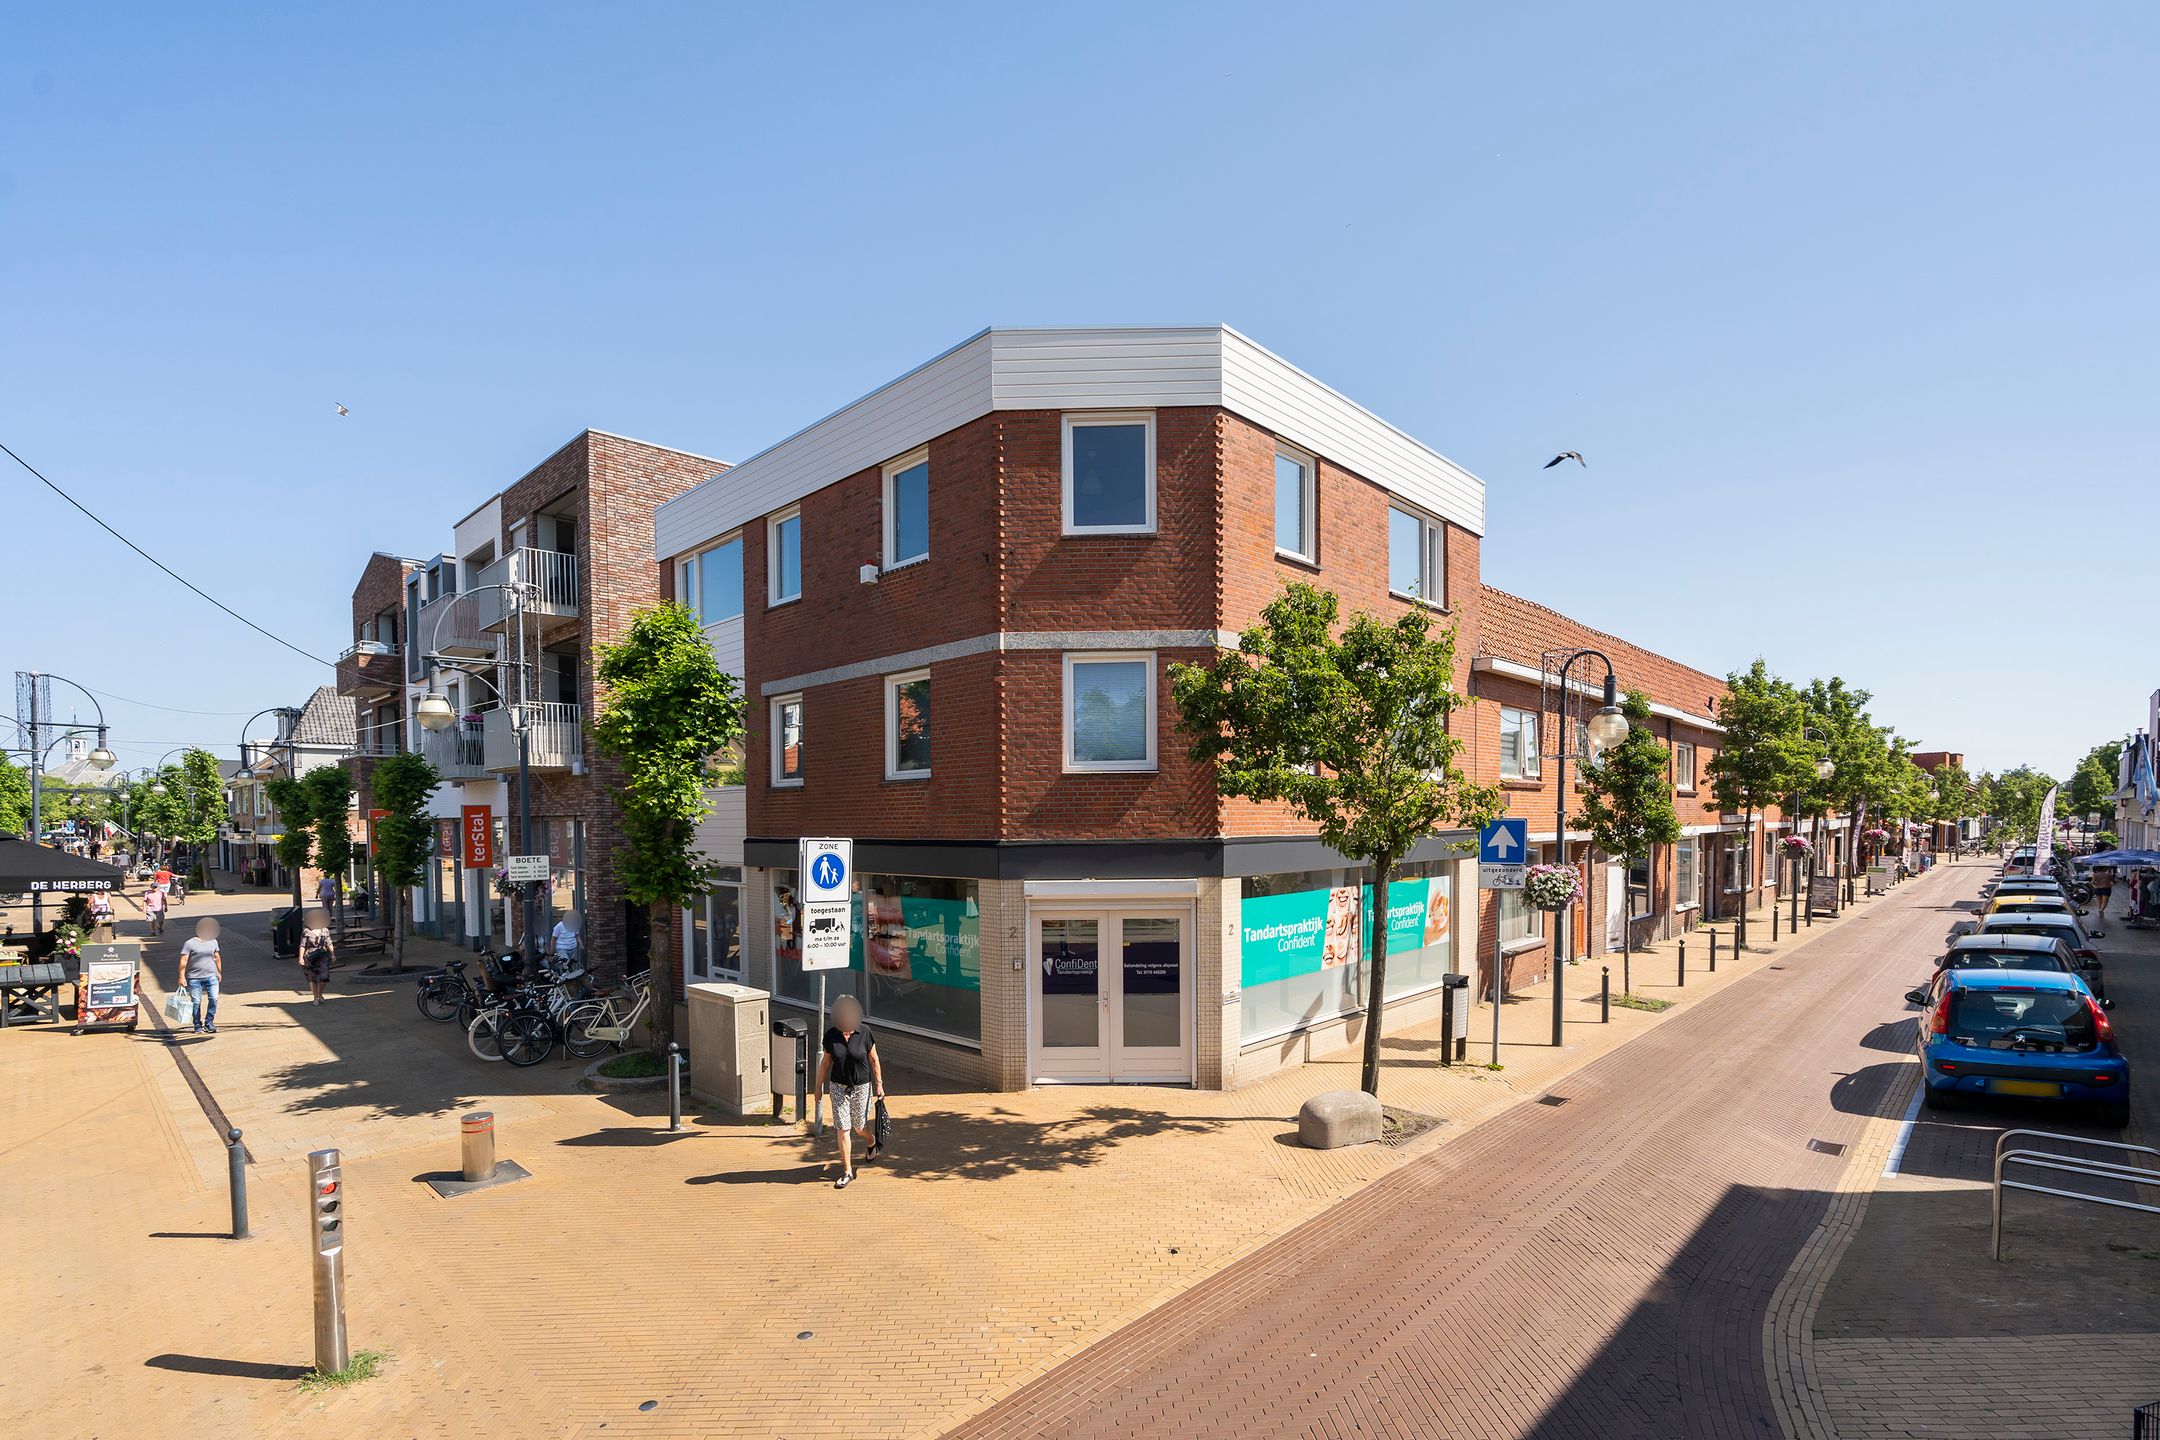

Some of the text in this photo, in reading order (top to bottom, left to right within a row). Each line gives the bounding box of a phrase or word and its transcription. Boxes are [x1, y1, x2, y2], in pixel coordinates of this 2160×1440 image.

[470, 812, 486, 862] terStal
[31, 880, 112, 890] DE HERBERG
[810, 907, 846, 916] toegestaan
[1228, 924, 1235, 936] 2
[1243, 916, 1324, 943] Tandartspraktijk
[1391, 915, 1419, 931] Confident
[908, 927, 980, 949] Tandartspraktijk
[1009, 926, 1018, 939] 2
[935, 942, 972, 958] Confident
[1277, 934, 1316, 953] Confident
[1054, 958, 1098, 969] ConfiDent
